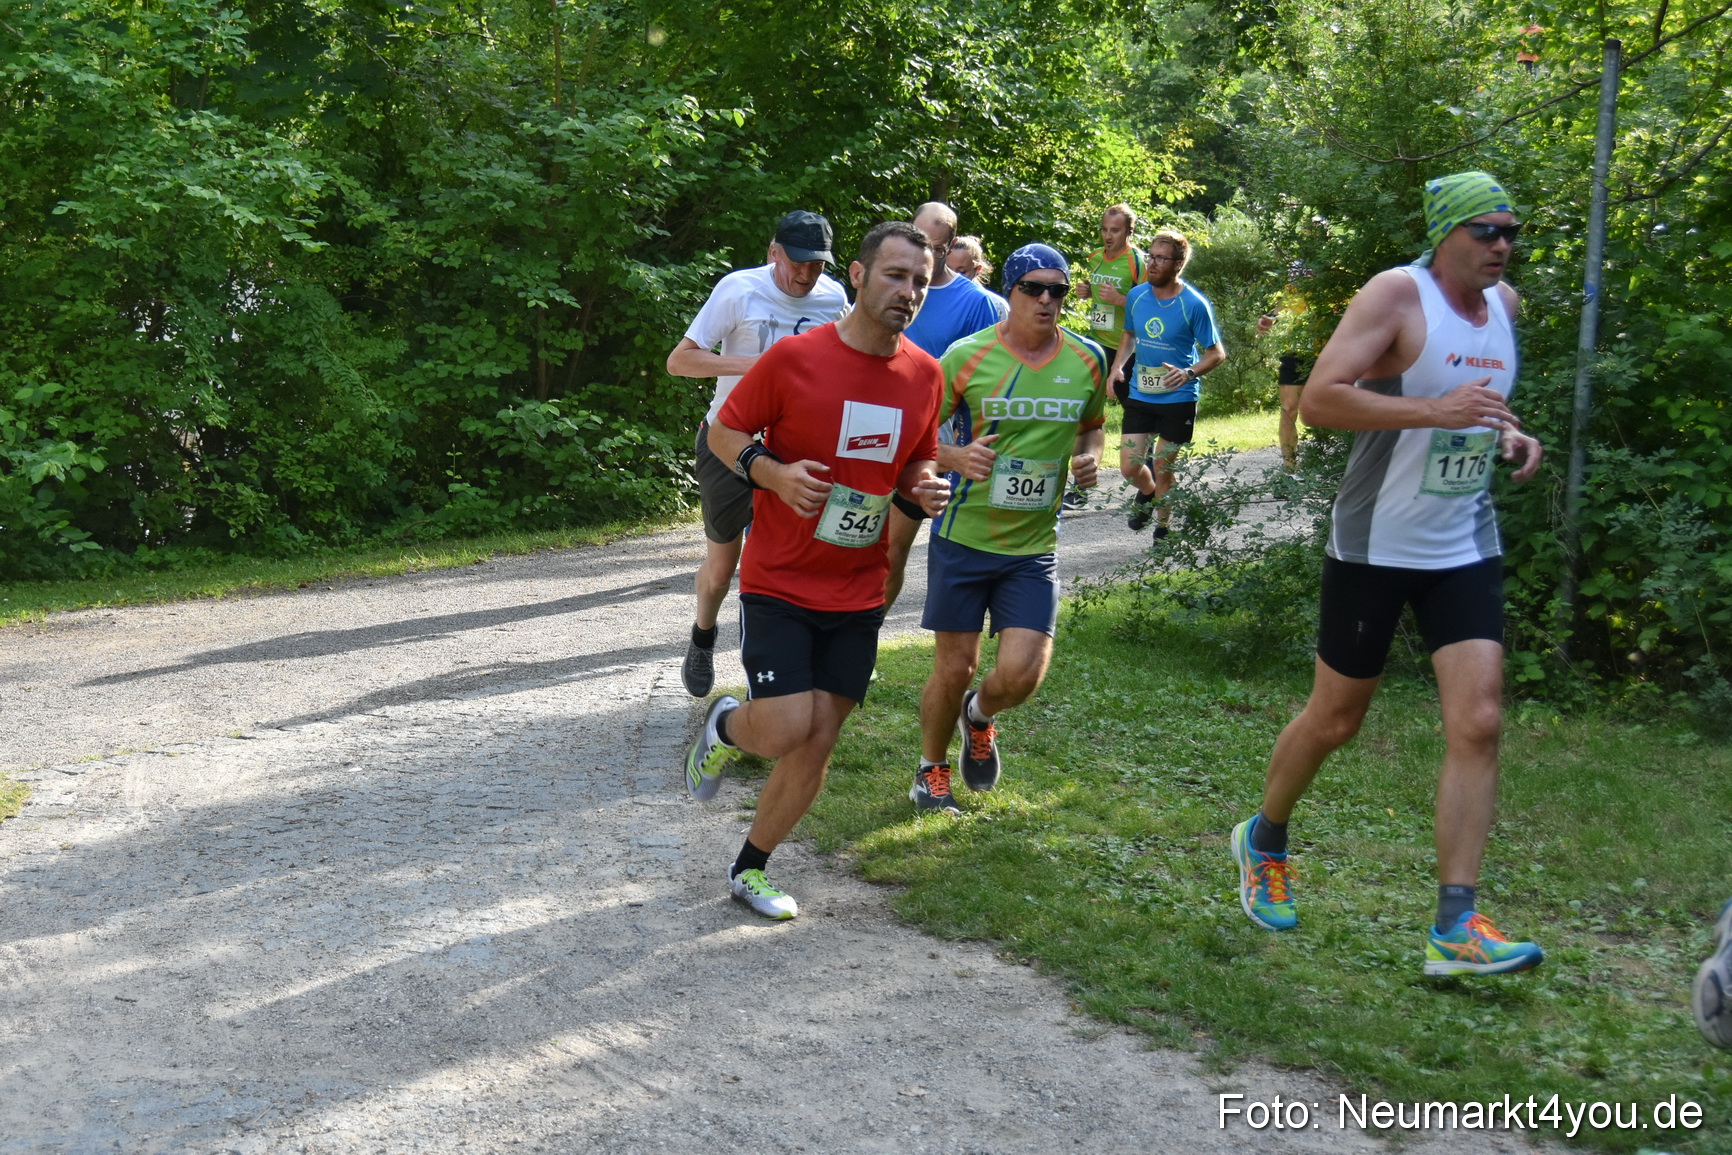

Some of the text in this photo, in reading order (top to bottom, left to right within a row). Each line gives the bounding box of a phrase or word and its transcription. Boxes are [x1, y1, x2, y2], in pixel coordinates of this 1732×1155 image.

[1465, 356, 1506, 371] KLEBL
[1141, 375, 1161, 387] 987
[981, 397, 1085, 422] BOCK
[1437, 453, 1488, 479] 1176
[1006, 476, 1046, 497] 304
[838, 510, 881, 534] 543
